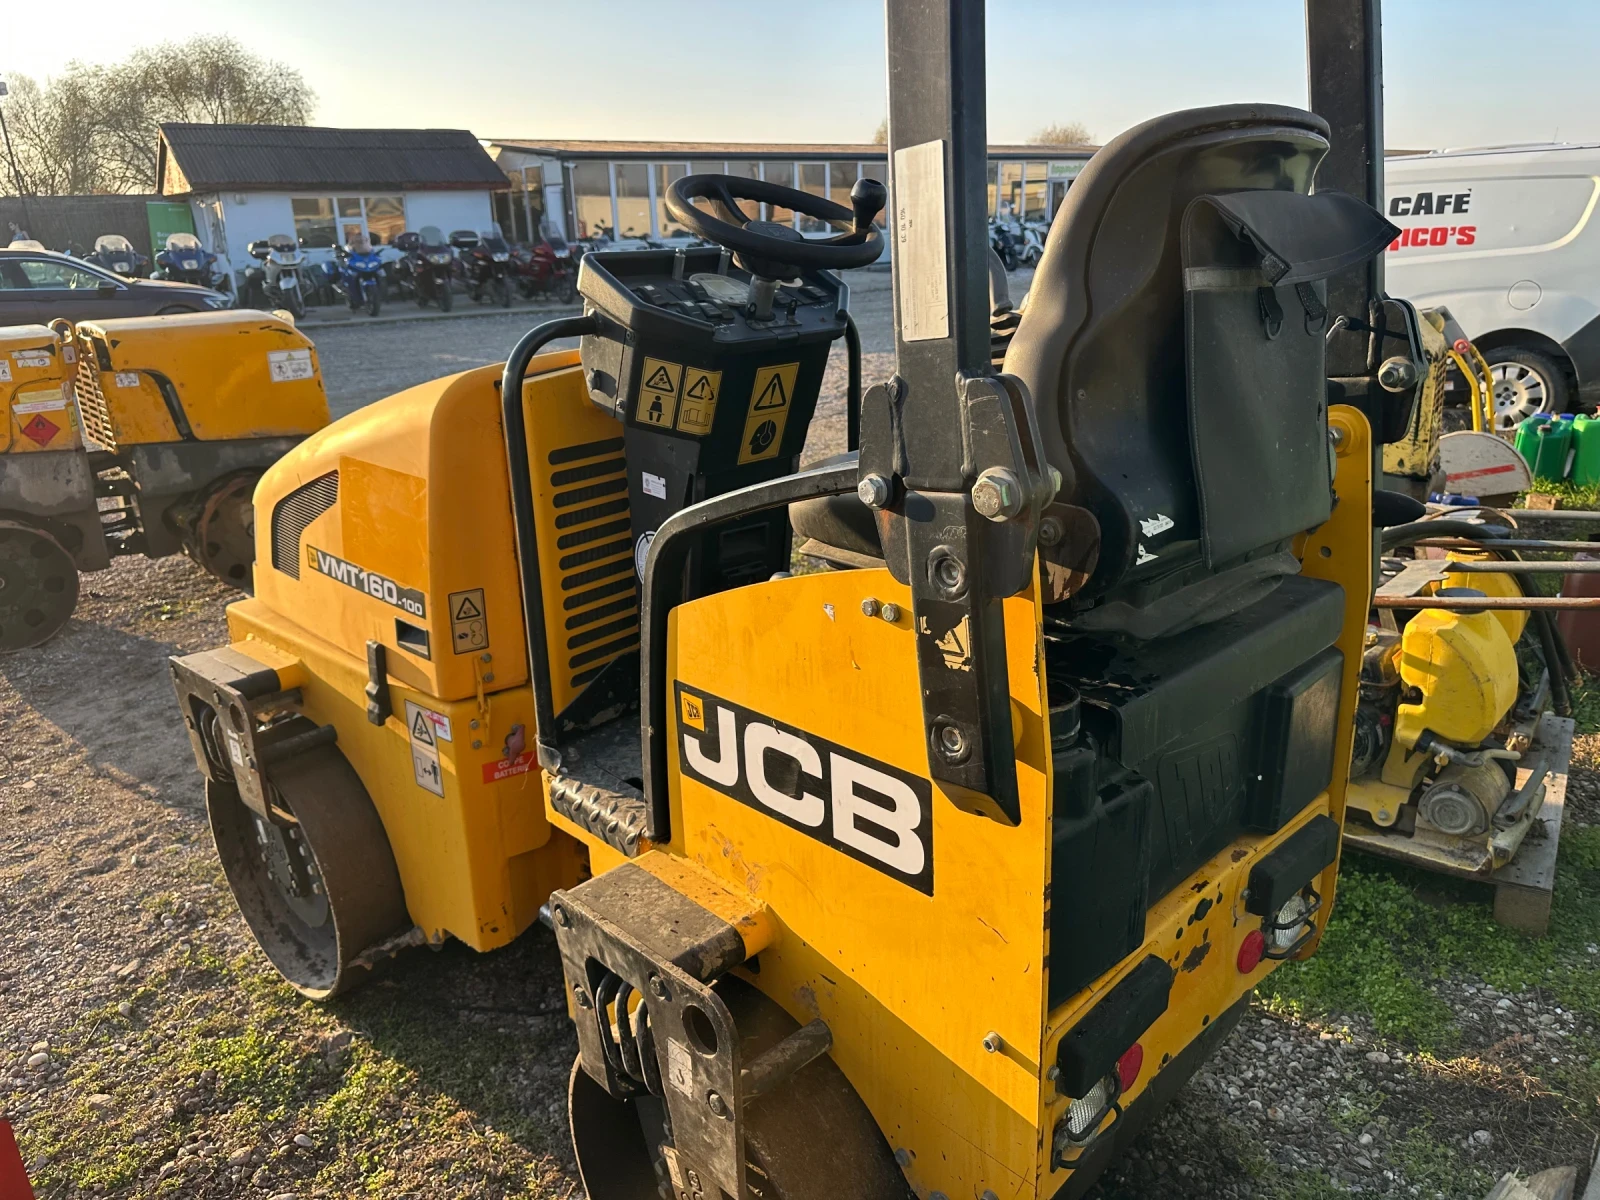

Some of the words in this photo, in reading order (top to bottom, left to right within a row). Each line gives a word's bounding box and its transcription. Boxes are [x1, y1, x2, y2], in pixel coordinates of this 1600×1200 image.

[497, 756, 524, 769] COPE
[494, 763, 528, 779] BATTERIE
[683, 705, 925, 875] JCB
